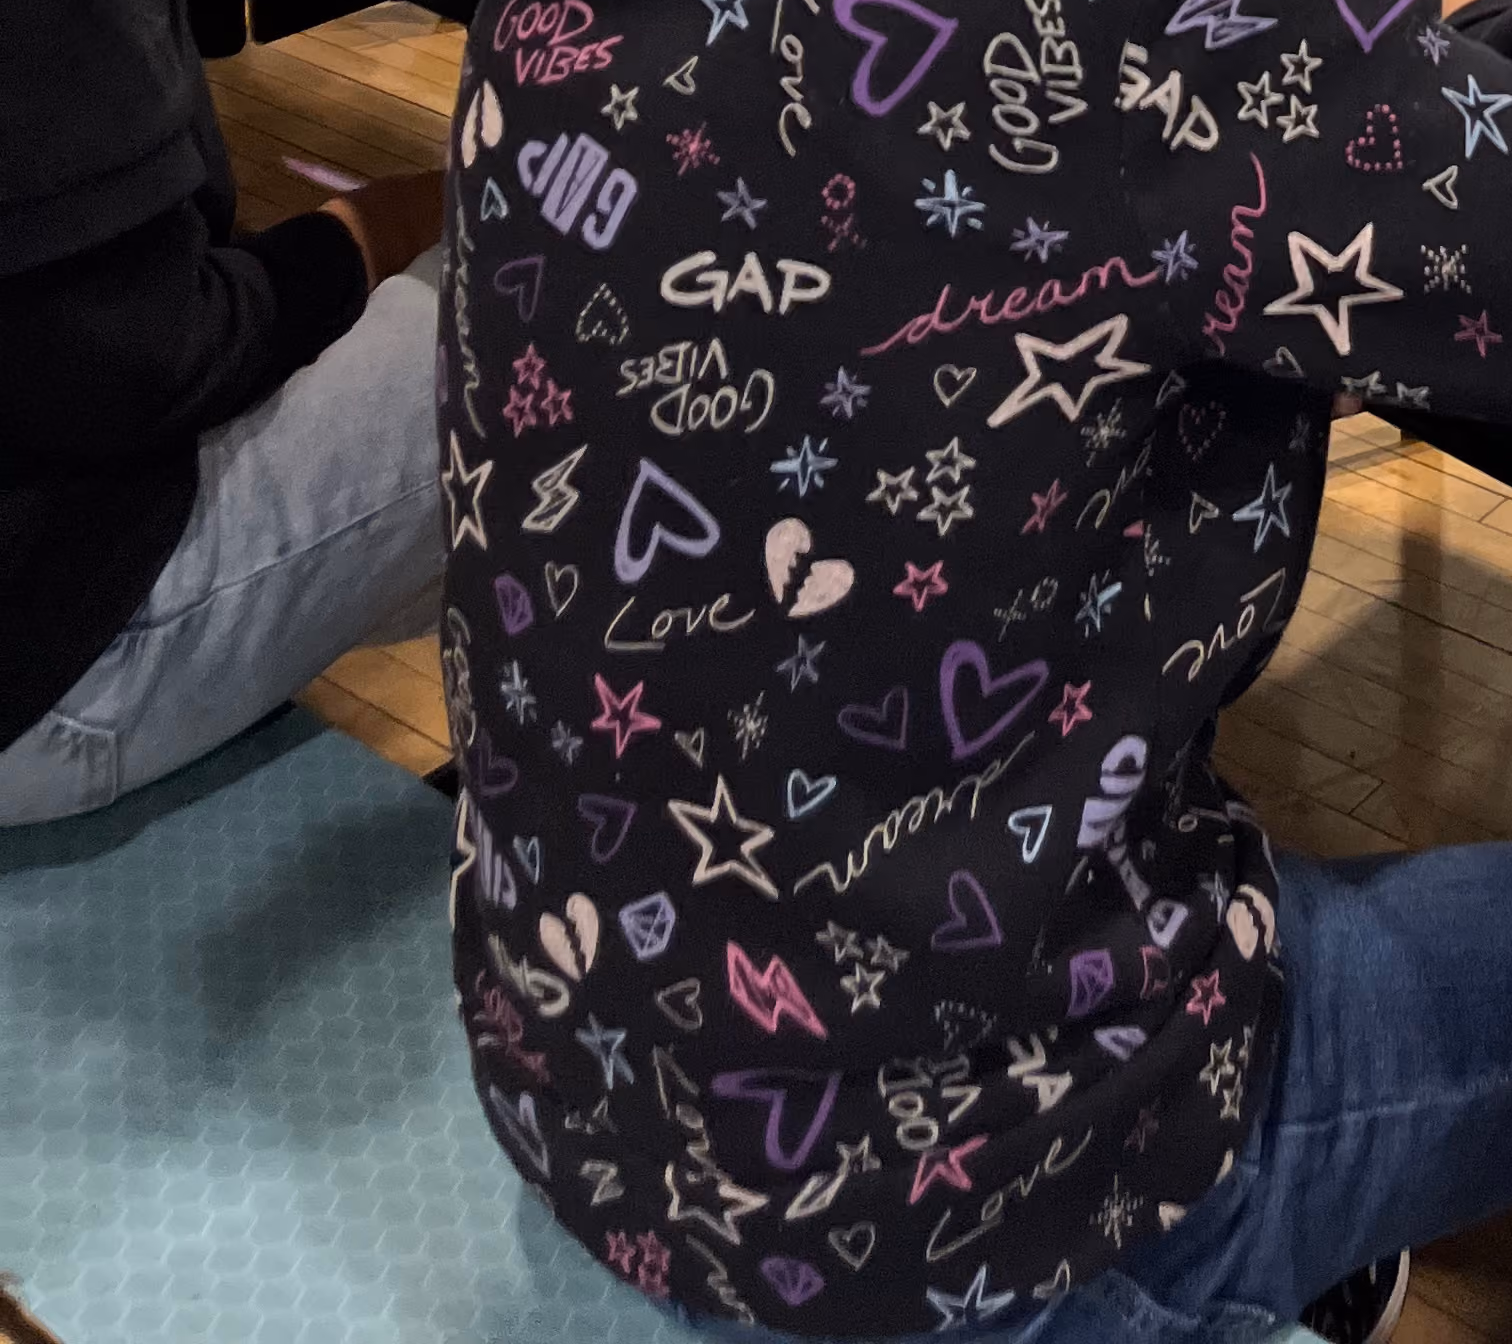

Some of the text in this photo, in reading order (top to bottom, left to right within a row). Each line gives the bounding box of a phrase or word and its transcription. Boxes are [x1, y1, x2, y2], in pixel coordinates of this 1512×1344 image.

[514, 34, 625, 87] VIBES
[983, 32, 1059, 174] GOOD
[660, 249, 832, 315] GAP
[1202, 152, 1267, 356] ream
[859, 255, 1160, 355] dream
[616, 337, 729, 397] VIBES
[650, 368, 776, 437] GOOD
